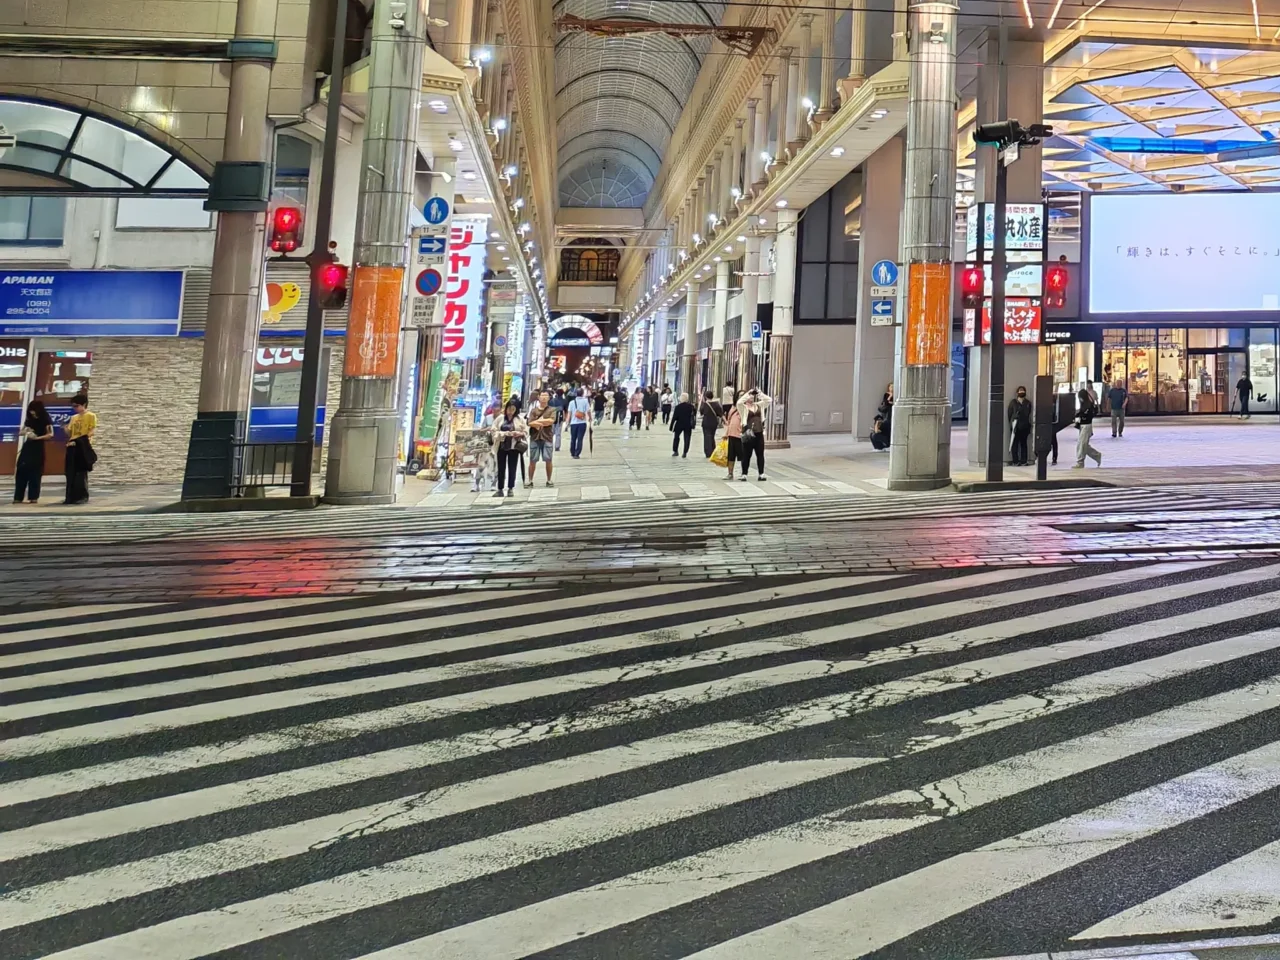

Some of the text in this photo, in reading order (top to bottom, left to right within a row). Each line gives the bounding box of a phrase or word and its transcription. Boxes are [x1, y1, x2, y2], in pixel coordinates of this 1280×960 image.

[1005, 216, 1041, 238] 丸水産
[2, 276, 54, 284] APAMAN
[443, 225, 474, 353] ジャンカラ
